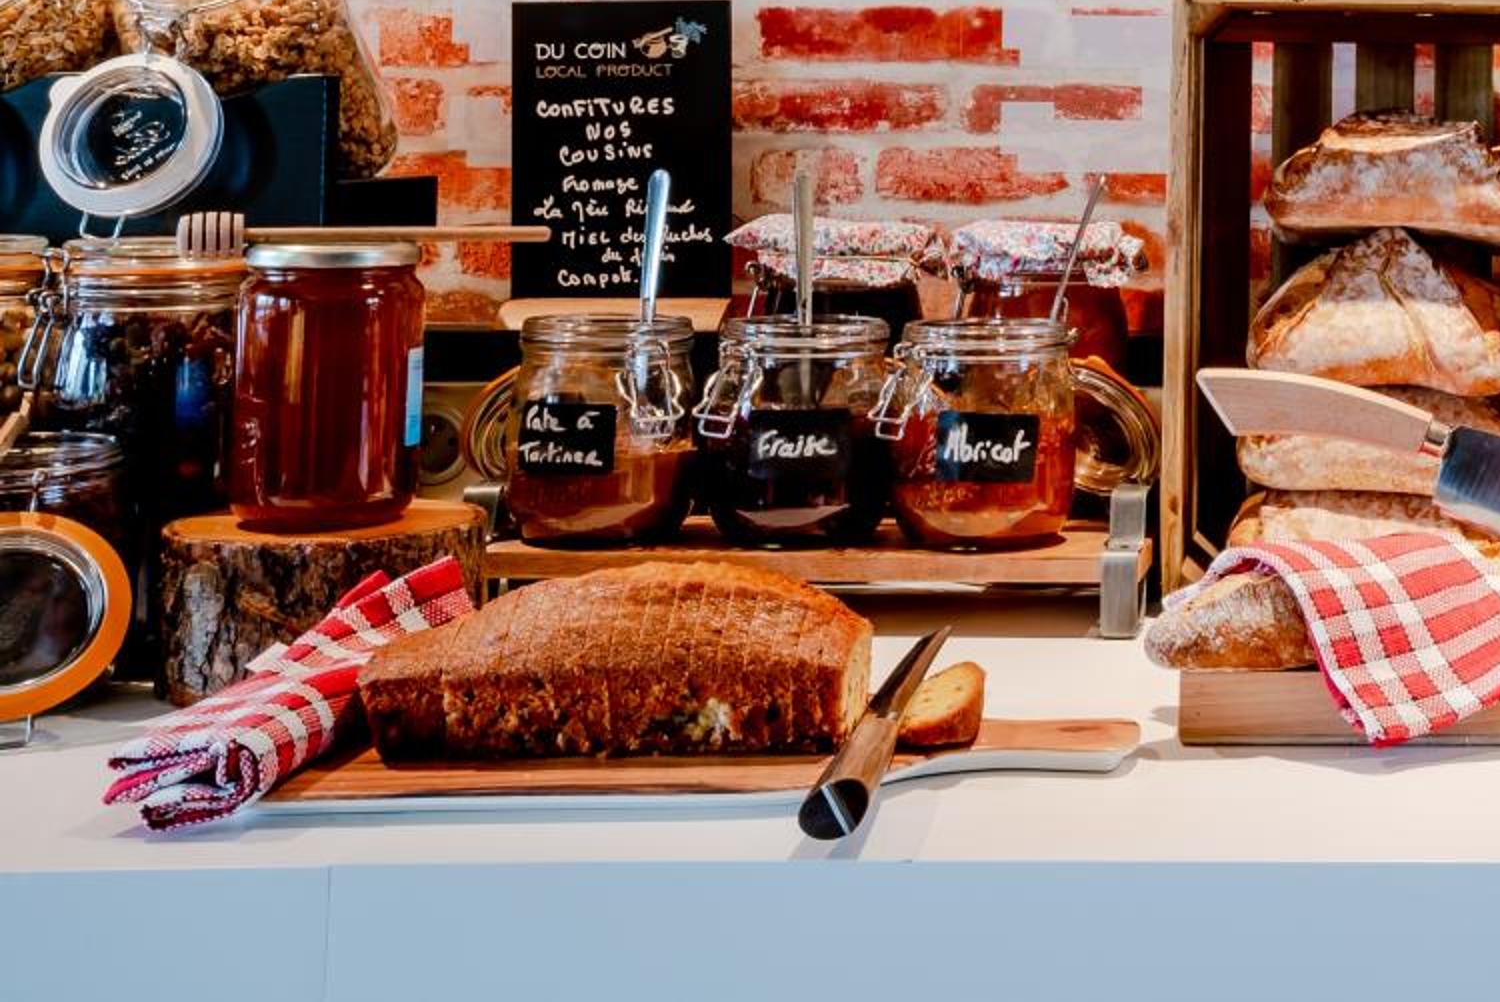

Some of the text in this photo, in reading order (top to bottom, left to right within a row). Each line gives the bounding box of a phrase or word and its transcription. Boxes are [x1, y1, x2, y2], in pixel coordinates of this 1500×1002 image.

[535, 42, 627, 60] DU COIN
[535, 63, 673, 79] LOCAL PRODUCT
[562, 174, 639, 195] Fromage
[757, 429, 837, 460] Fraise
[943, 422, 1031, 464] Abricot
